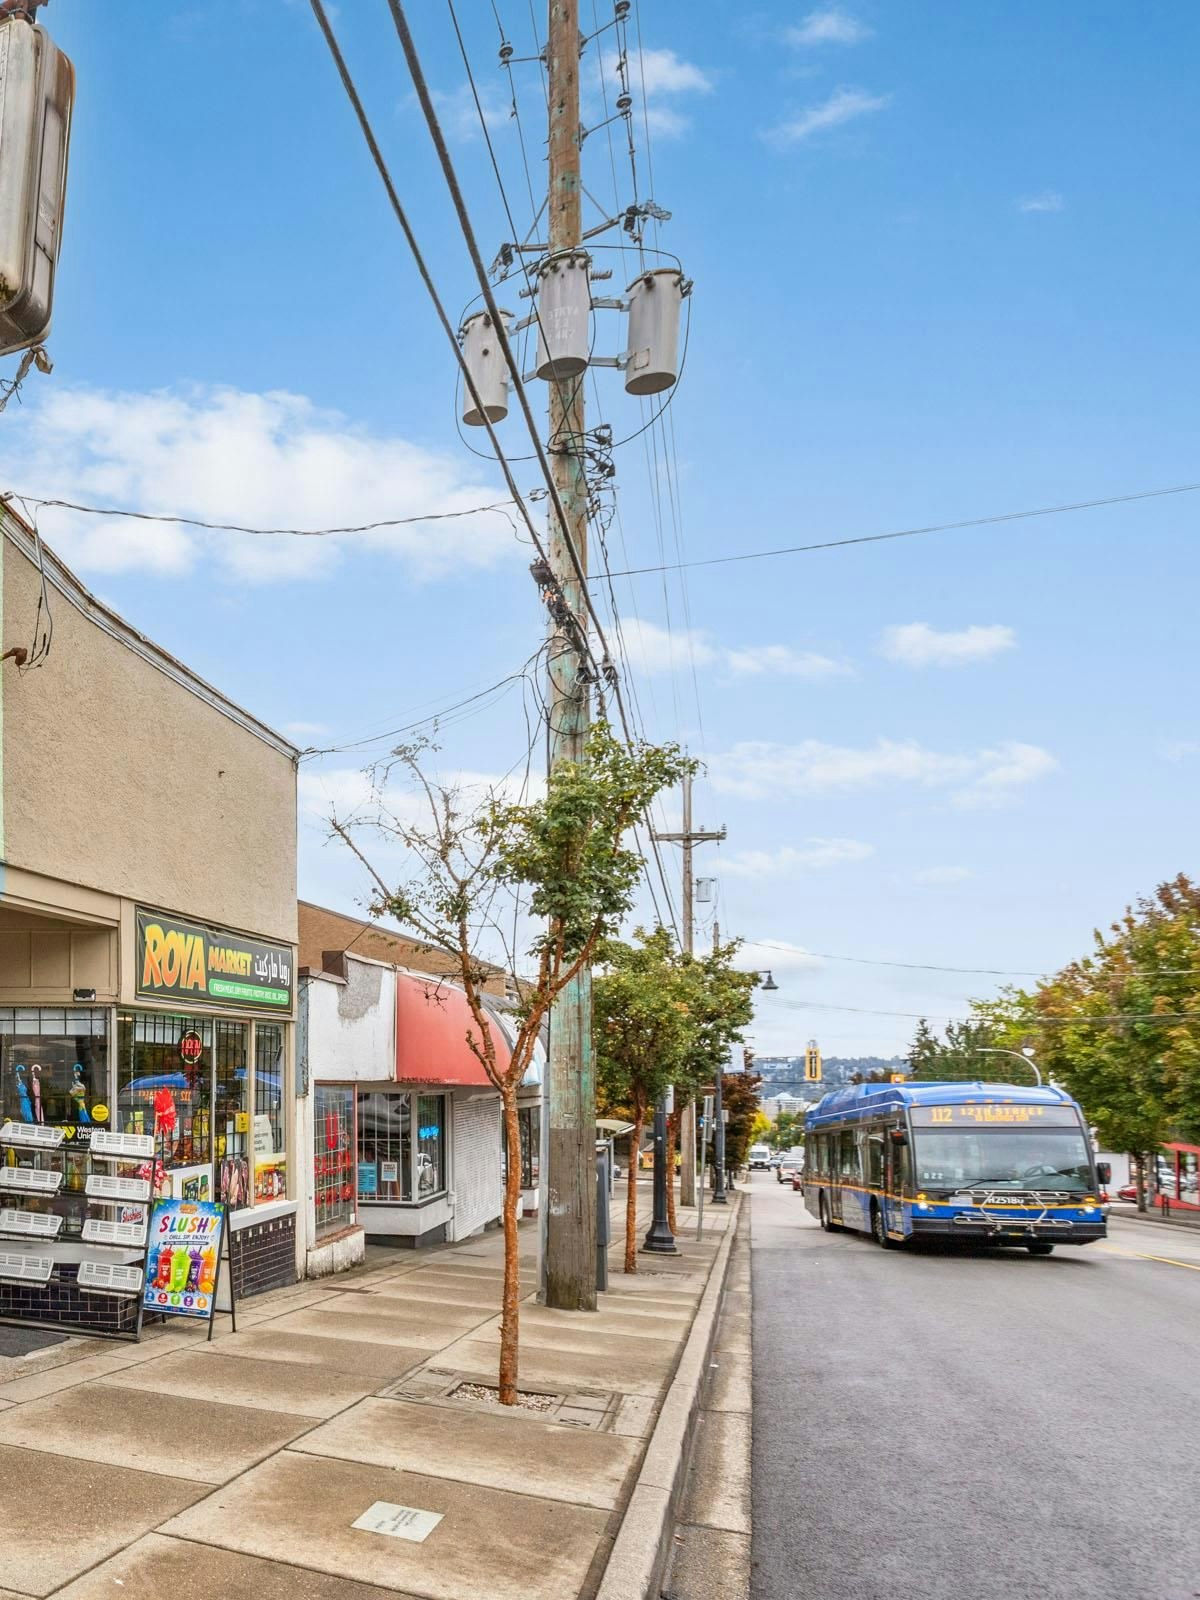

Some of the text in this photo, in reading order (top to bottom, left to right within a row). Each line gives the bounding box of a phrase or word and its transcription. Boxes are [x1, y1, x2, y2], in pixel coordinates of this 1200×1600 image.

[142, 923, 252, 992] ROYA MARKET
[931, 1107, 953, 1122] 112
[159, 1215, 221, 1233] SLUSHY
